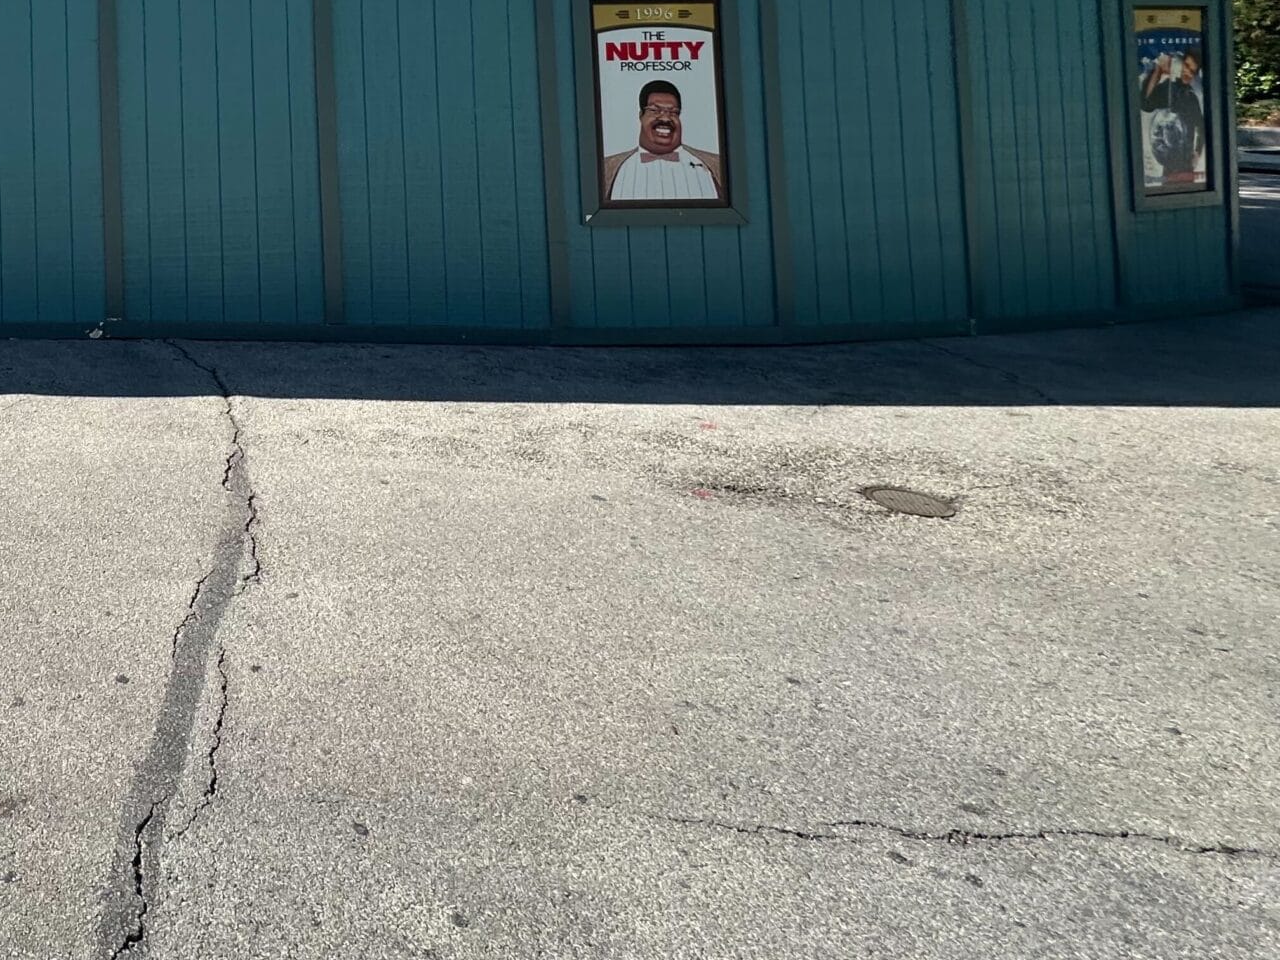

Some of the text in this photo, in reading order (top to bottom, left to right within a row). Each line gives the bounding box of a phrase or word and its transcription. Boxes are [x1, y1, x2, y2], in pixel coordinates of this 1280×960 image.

[635, 7, 673, 20] 1996
[641, 31, 665, 41] THE
[605, 41, 705, 61] NUTTY
[620, 61, 692, 72] PROFESSOR
